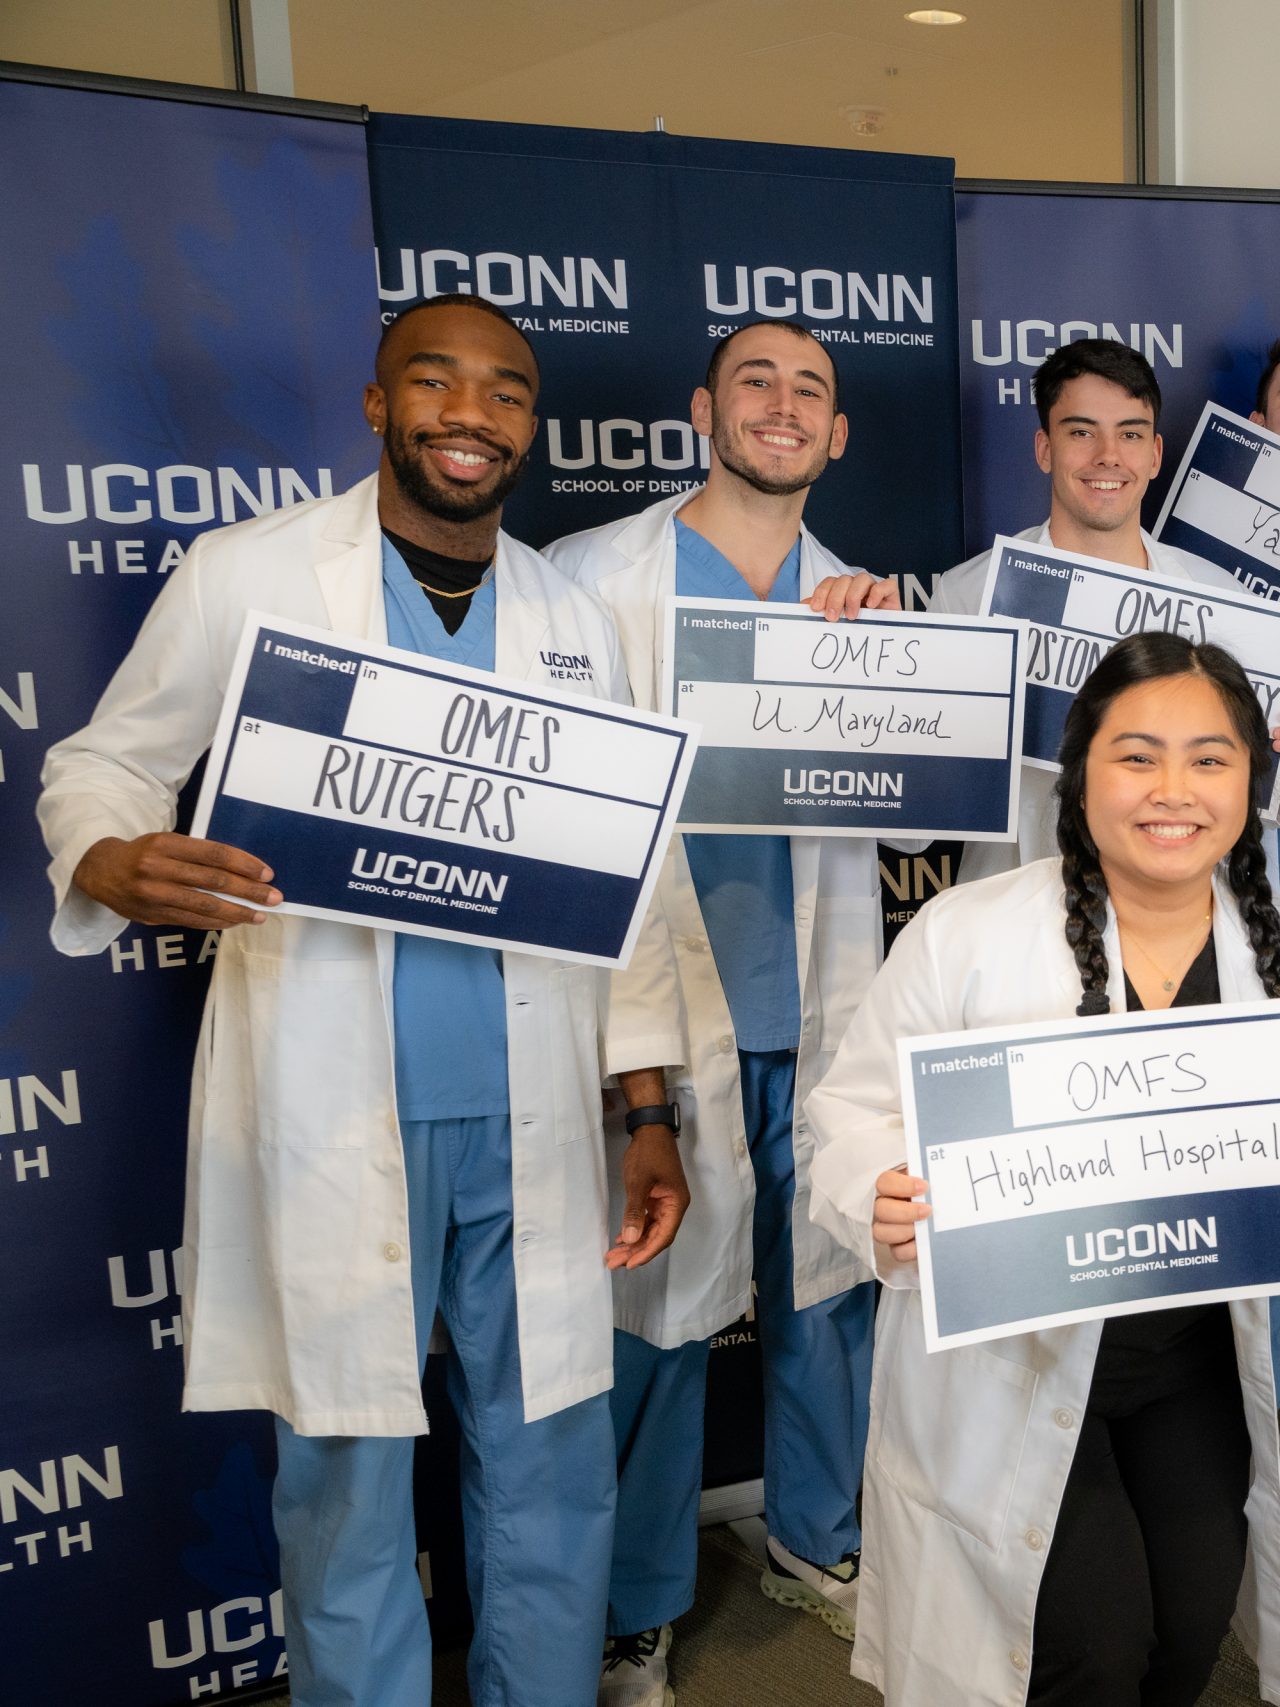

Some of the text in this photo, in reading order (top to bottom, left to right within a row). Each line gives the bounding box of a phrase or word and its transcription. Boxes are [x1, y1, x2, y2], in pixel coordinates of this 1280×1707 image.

[374, 247, 628, 309] UCONN
[704, 264, 933, 323] UCONN
[512, 317, 629, 333] TAL MEDICINE
[811, 330, 859, 343] ENTAL
[864, 331, 934, 346] MEDICINE
[547, 418, 710, 469] UCO
[1216, 426, 1261, 452] matched!
[1262, 446, 1272, 457] in
[551, 480, 619, 492] SCHOOL
[622, 480, 645, 492] OF
[1190, 472, 1201, 481] at
[68, 540, 187, 574] HEA
[1007, 556, 1085, 583] I matched! in
[691, 618, 753, 632] matched!
[758, 620, 770, 632] in
[263, 639, 378, 680] I matched! in
[540, 650, 593, 671] UCONN
[811, 633, 920, 677] OMFS
[550, 669, 593, 682] HEALTH
[681, 683, 694, 694] at
[243, 721, 261, 735] at
[440, 693, 560, 773] OMFS
[752, 690, 952, 748] U. Maryland
[313, 744, 525, 843] RUTGERS
[783, 768, 904, 798] UCONN
[783, 798, 902, 809] SCHOOL OF DENTAL MEDICINE
[351, 847, 509, 902] UCONN
[347, 880, 499, 915] SCHOOL OF DENTAL MEDICINE
[111, 930, 222, 974] HEA
[921, 1050, 1024, 1075] I matched! in
[1067, 1052, 1207, 1112] OMFS
[929, 1147, 945, 1161] at
[965, 1122, 1280, 1211] Highland Hospital
[1065, 1215, 1218, 1267] UCONN
[1069, 1253, 1219, 1283] SCHOOL OF DENTAL MEDICINE
[710, 1331, 757, 1349] ENTAL
